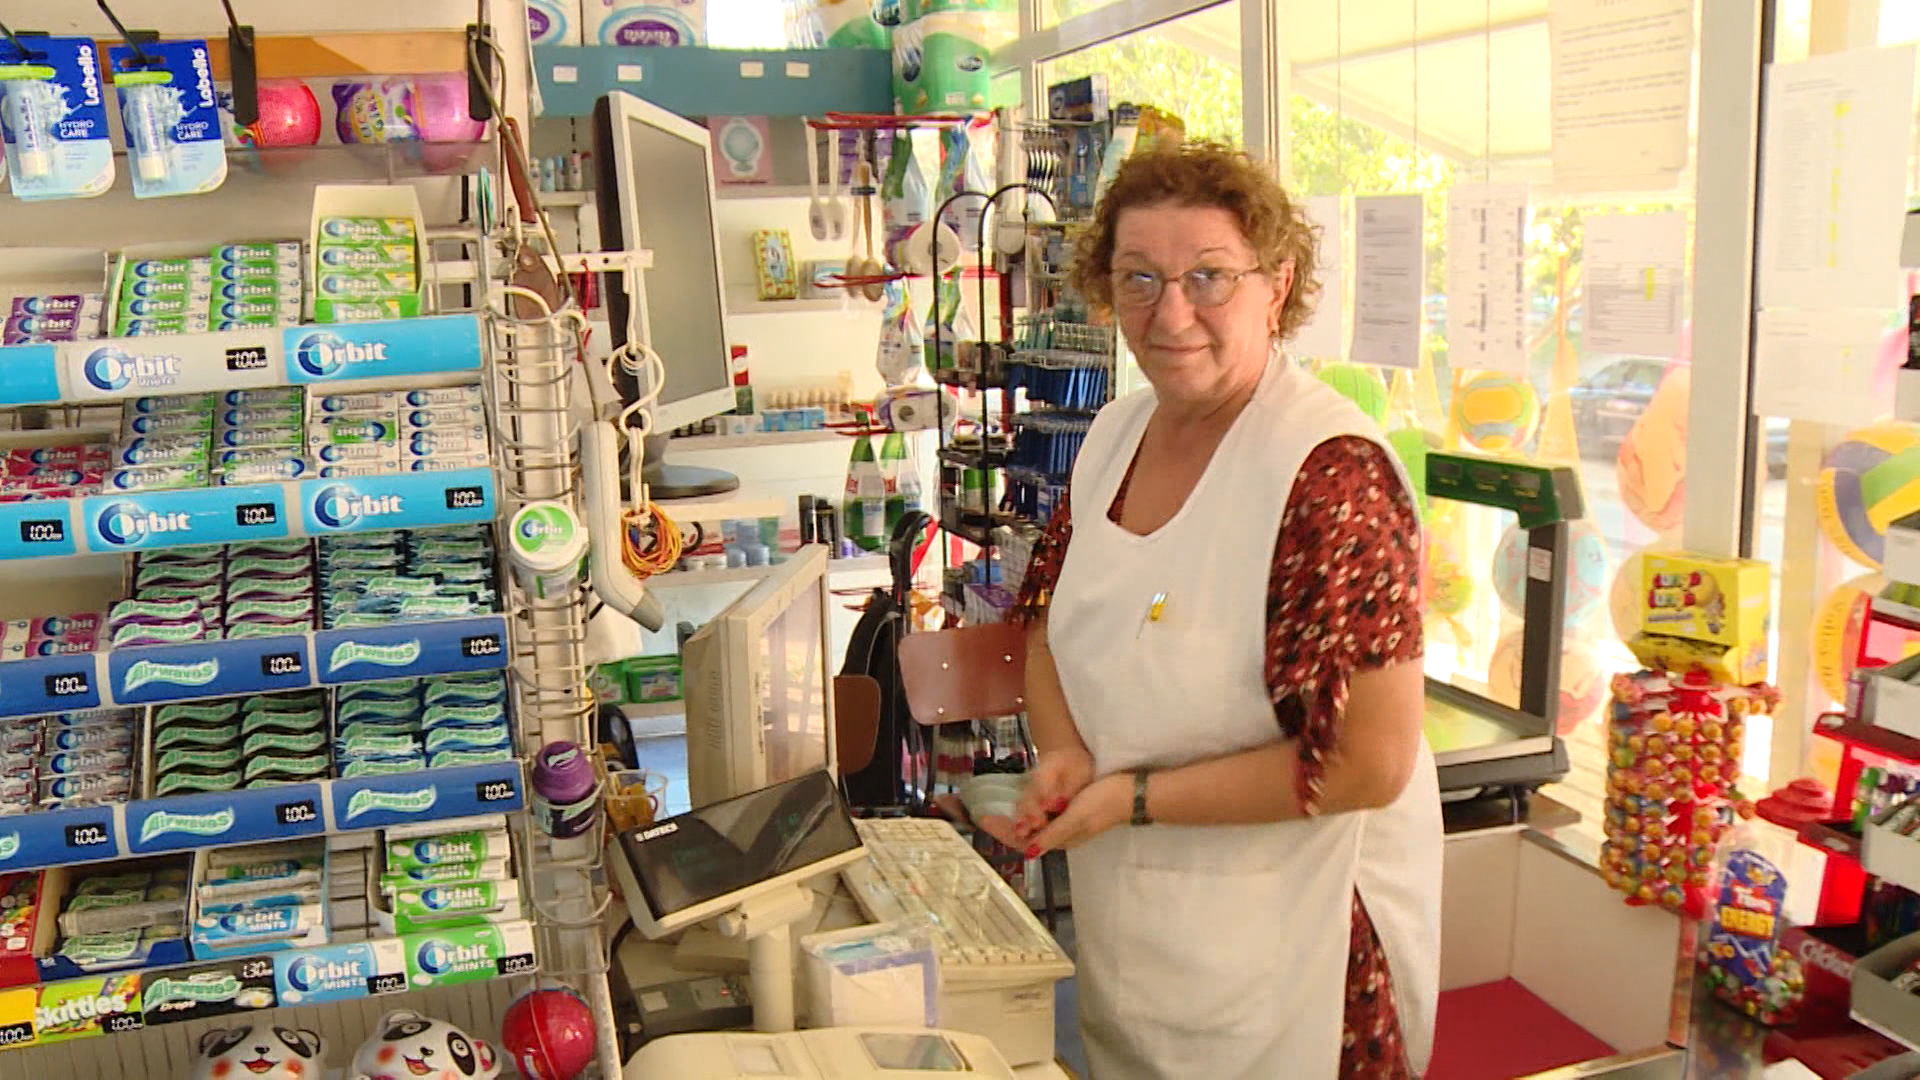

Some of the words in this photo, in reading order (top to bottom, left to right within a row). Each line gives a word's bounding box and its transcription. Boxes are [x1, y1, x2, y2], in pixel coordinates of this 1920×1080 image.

[77, 45, 99, 106] Labello
[192, 48, 213, 107] Labello
[60, 128, 88, 138] CARE
[177, 129, 203, 139] CARE
[84, 348, 179, 390] Orbit
[297, 333, 389, 376] Orbit
[315, 486, 404, 527] Orbit
[98, 504, 192, 544] Orbit
[126, 661, 216, 690] Airwaves
[142, 812, 232, 838] Airwaves
[414, 841, 472, 863] Orbit
[421, 887, 481, 910] Orbit
[220, 911, 283, 932] Orbit
[417, 940, 489, 975] Orbit
[453, 959, 495, 972] MINTS
[288, 956, 361, 992] Orbit
[324, 976, 366, 990] MINTS
[144, 977, 238, 1010] Airwaves
